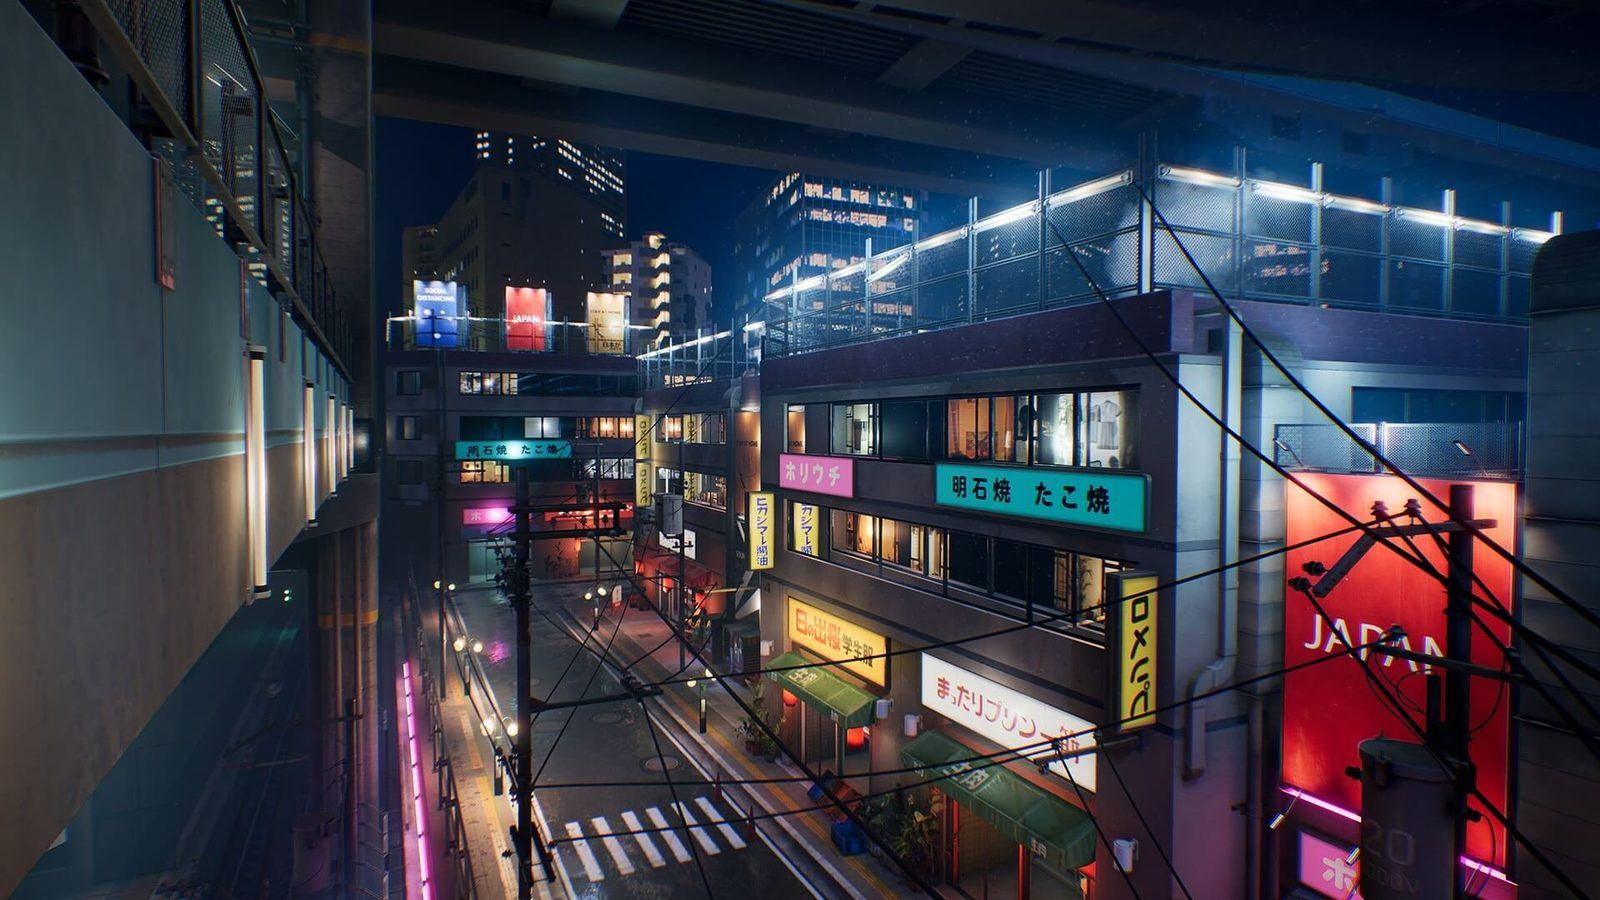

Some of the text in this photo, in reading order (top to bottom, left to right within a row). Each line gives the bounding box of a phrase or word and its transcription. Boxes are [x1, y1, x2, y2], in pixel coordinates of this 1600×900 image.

[512, 314, 540, 324] JAPAN
[785, 460, 841, 488] ホリウチ
[952, 475, 1111, 515] 明石焼 たこ焼
